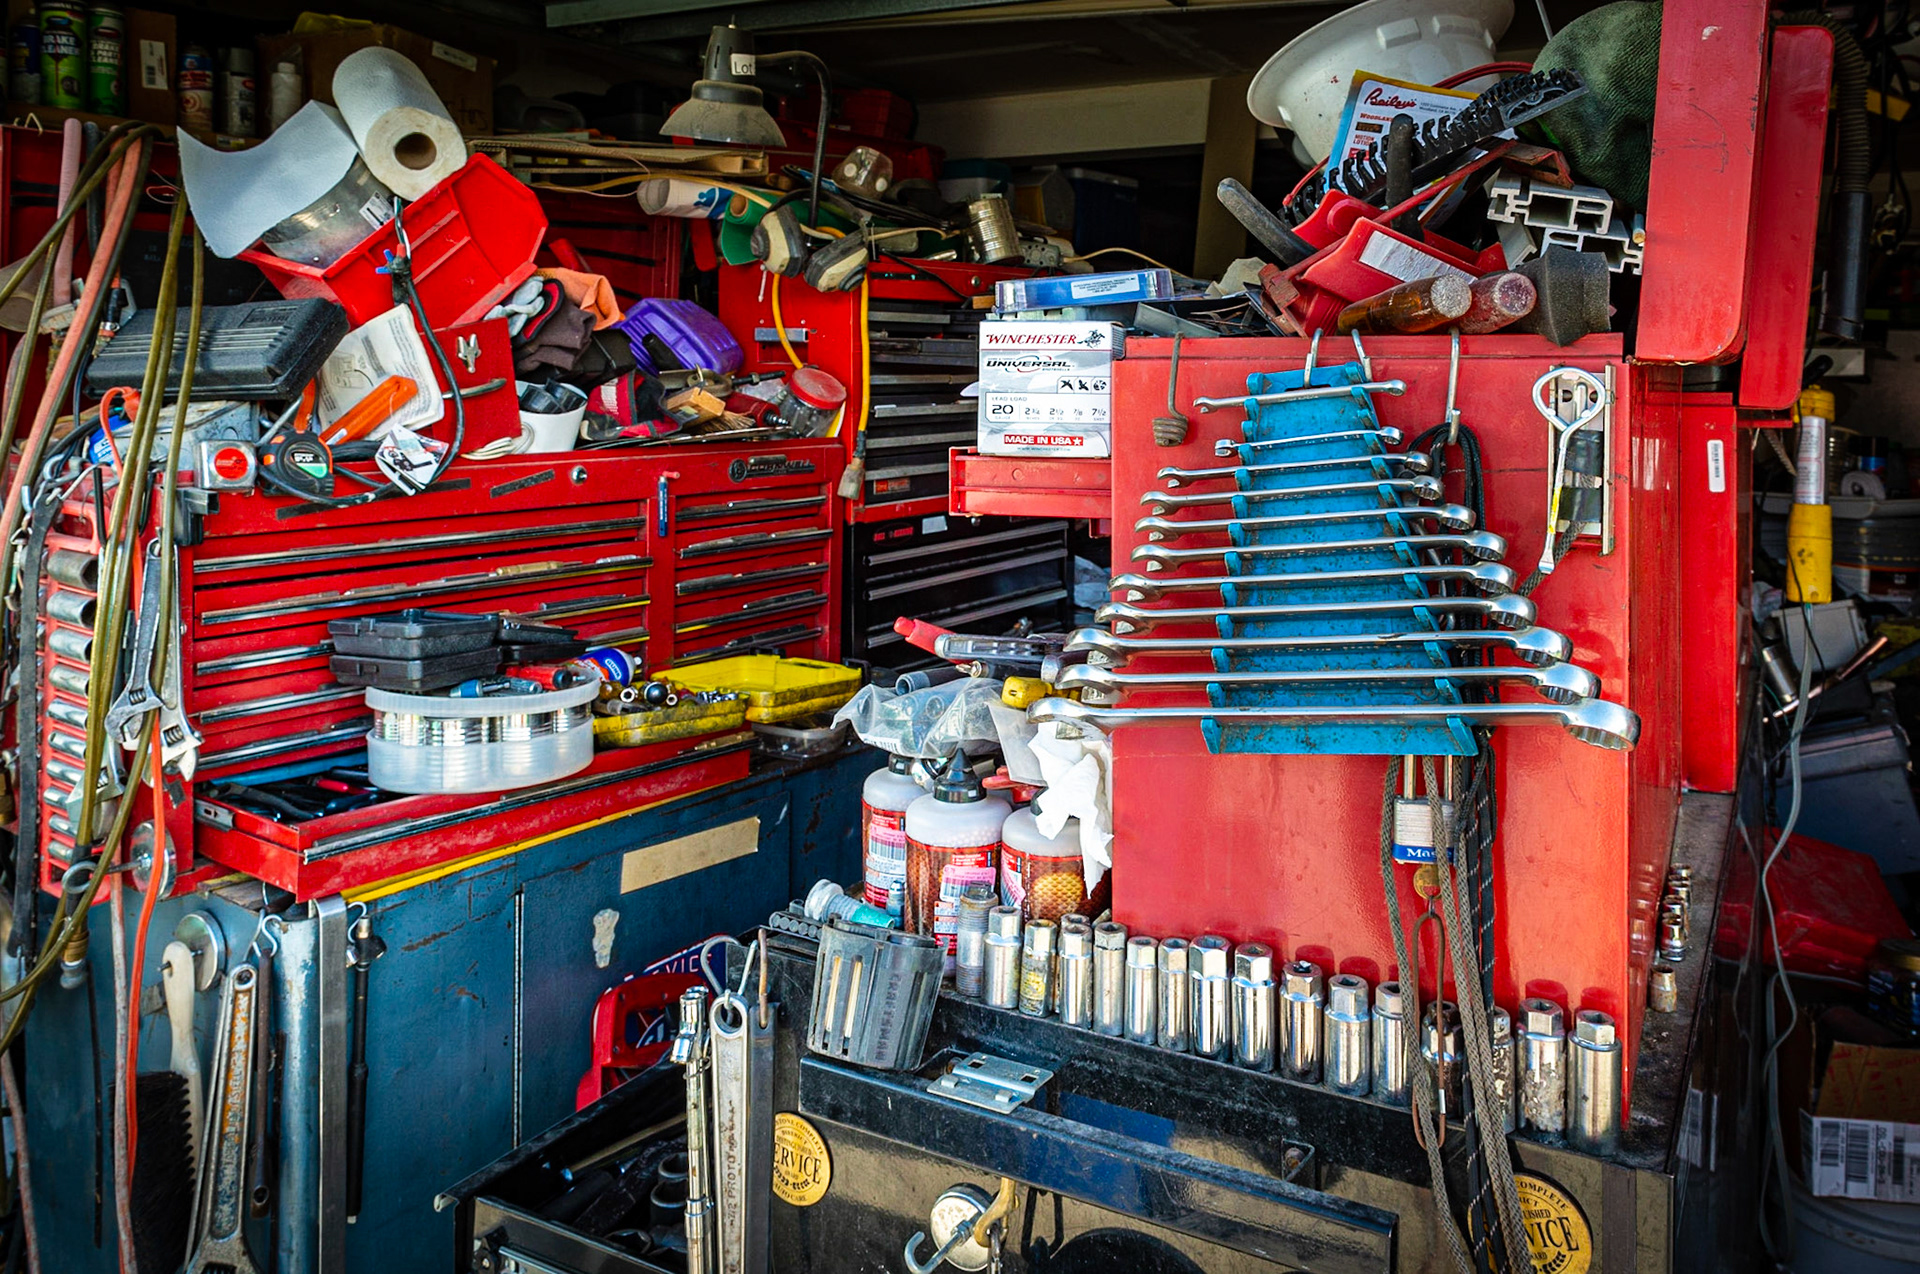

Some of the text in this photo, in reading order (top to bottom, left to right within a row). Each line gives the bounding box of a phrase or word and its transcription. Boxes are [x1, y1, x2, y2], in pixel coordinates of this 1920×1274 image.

[43, 34, 76, 46] BRAKE
[986, 333, 1078, 345] WINCHESTER
[986, 360, 1071, 368] UNIVERSAL
[992, 404, 1014, 415] 20
[1005, 435, 1072, 445] MADE IN USA
[774, 1143, 822, 1185] ERVICE
[727, 1155, 737, 1200] PROTO
[1525, 1216, 1580, 1253] VICE
